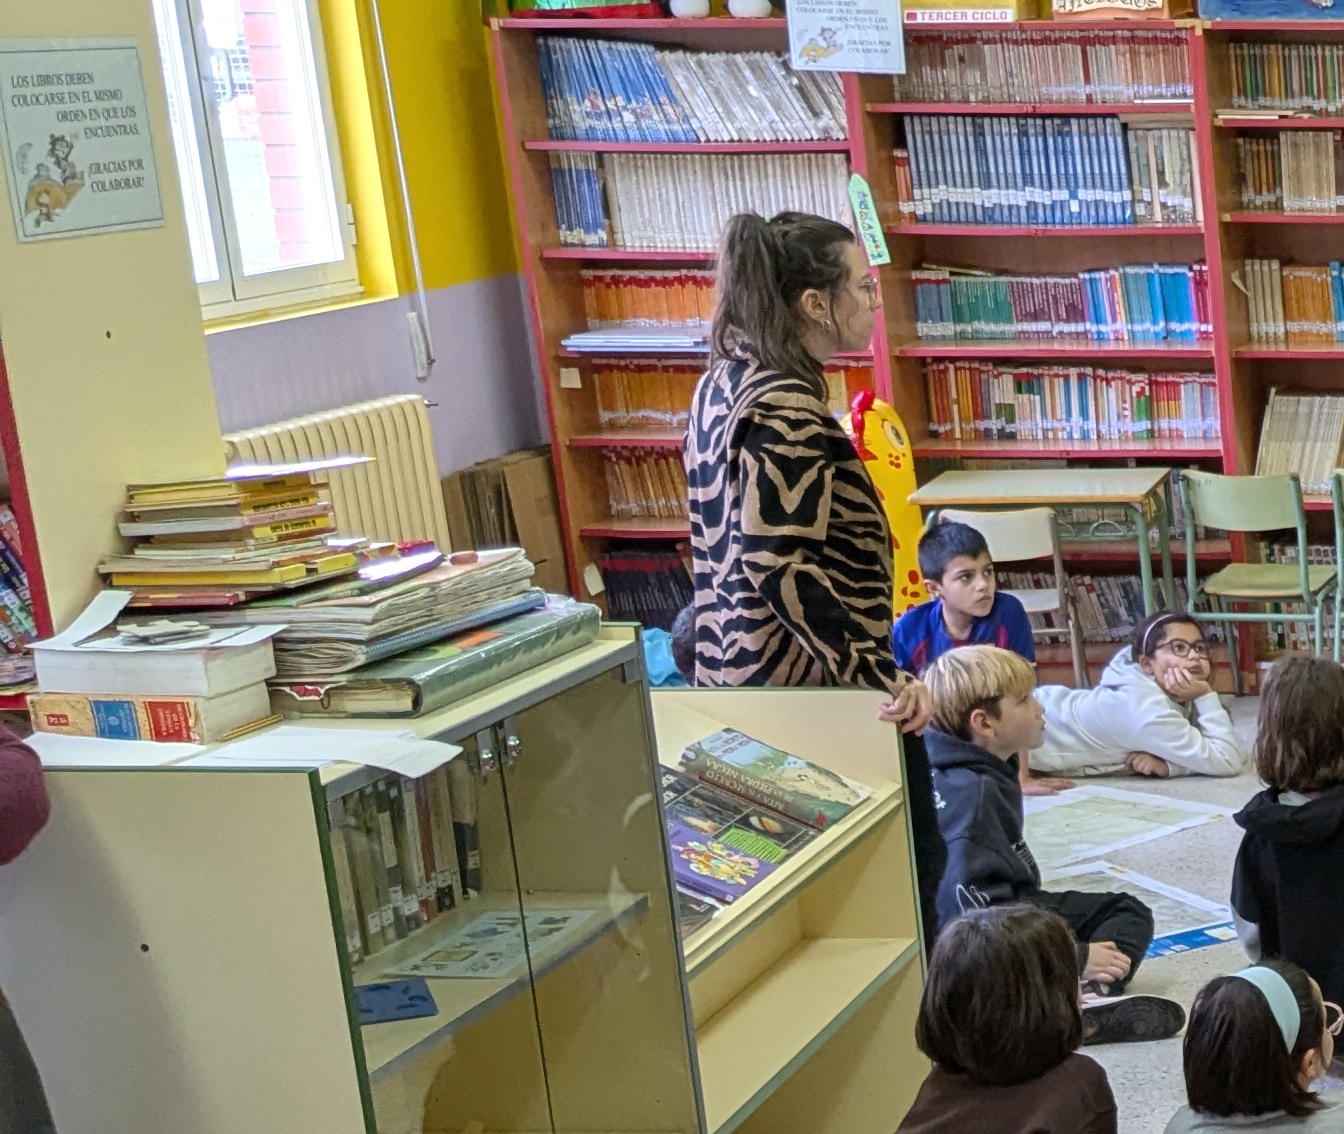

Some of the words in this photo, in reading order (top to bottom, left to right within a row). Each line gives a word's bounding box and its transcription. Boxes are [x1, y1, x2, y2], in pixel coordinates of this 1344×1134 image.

[919, 11, 969, 21] TERCER
[972, 10, 1007, 21] CICLO
[11, 76, 29, 88] LOS
[30, 74, 64, 87] LIBROS
[66, 73, 94, 86] DEBEN
[12, 93, 67, 107] COLOCARSE
[68, 92, 81, 103] EN
[82, 91, 92, 102] EL
[93, 89, 122, 101] MISMO
[57, 110, 87, 123] ORDEN
[89, 108, 101, 121] EN
[102, 108, 121, 121] QUE
[122, 106, 136, 118] LOS
[129, 159, 144, 171] POR
